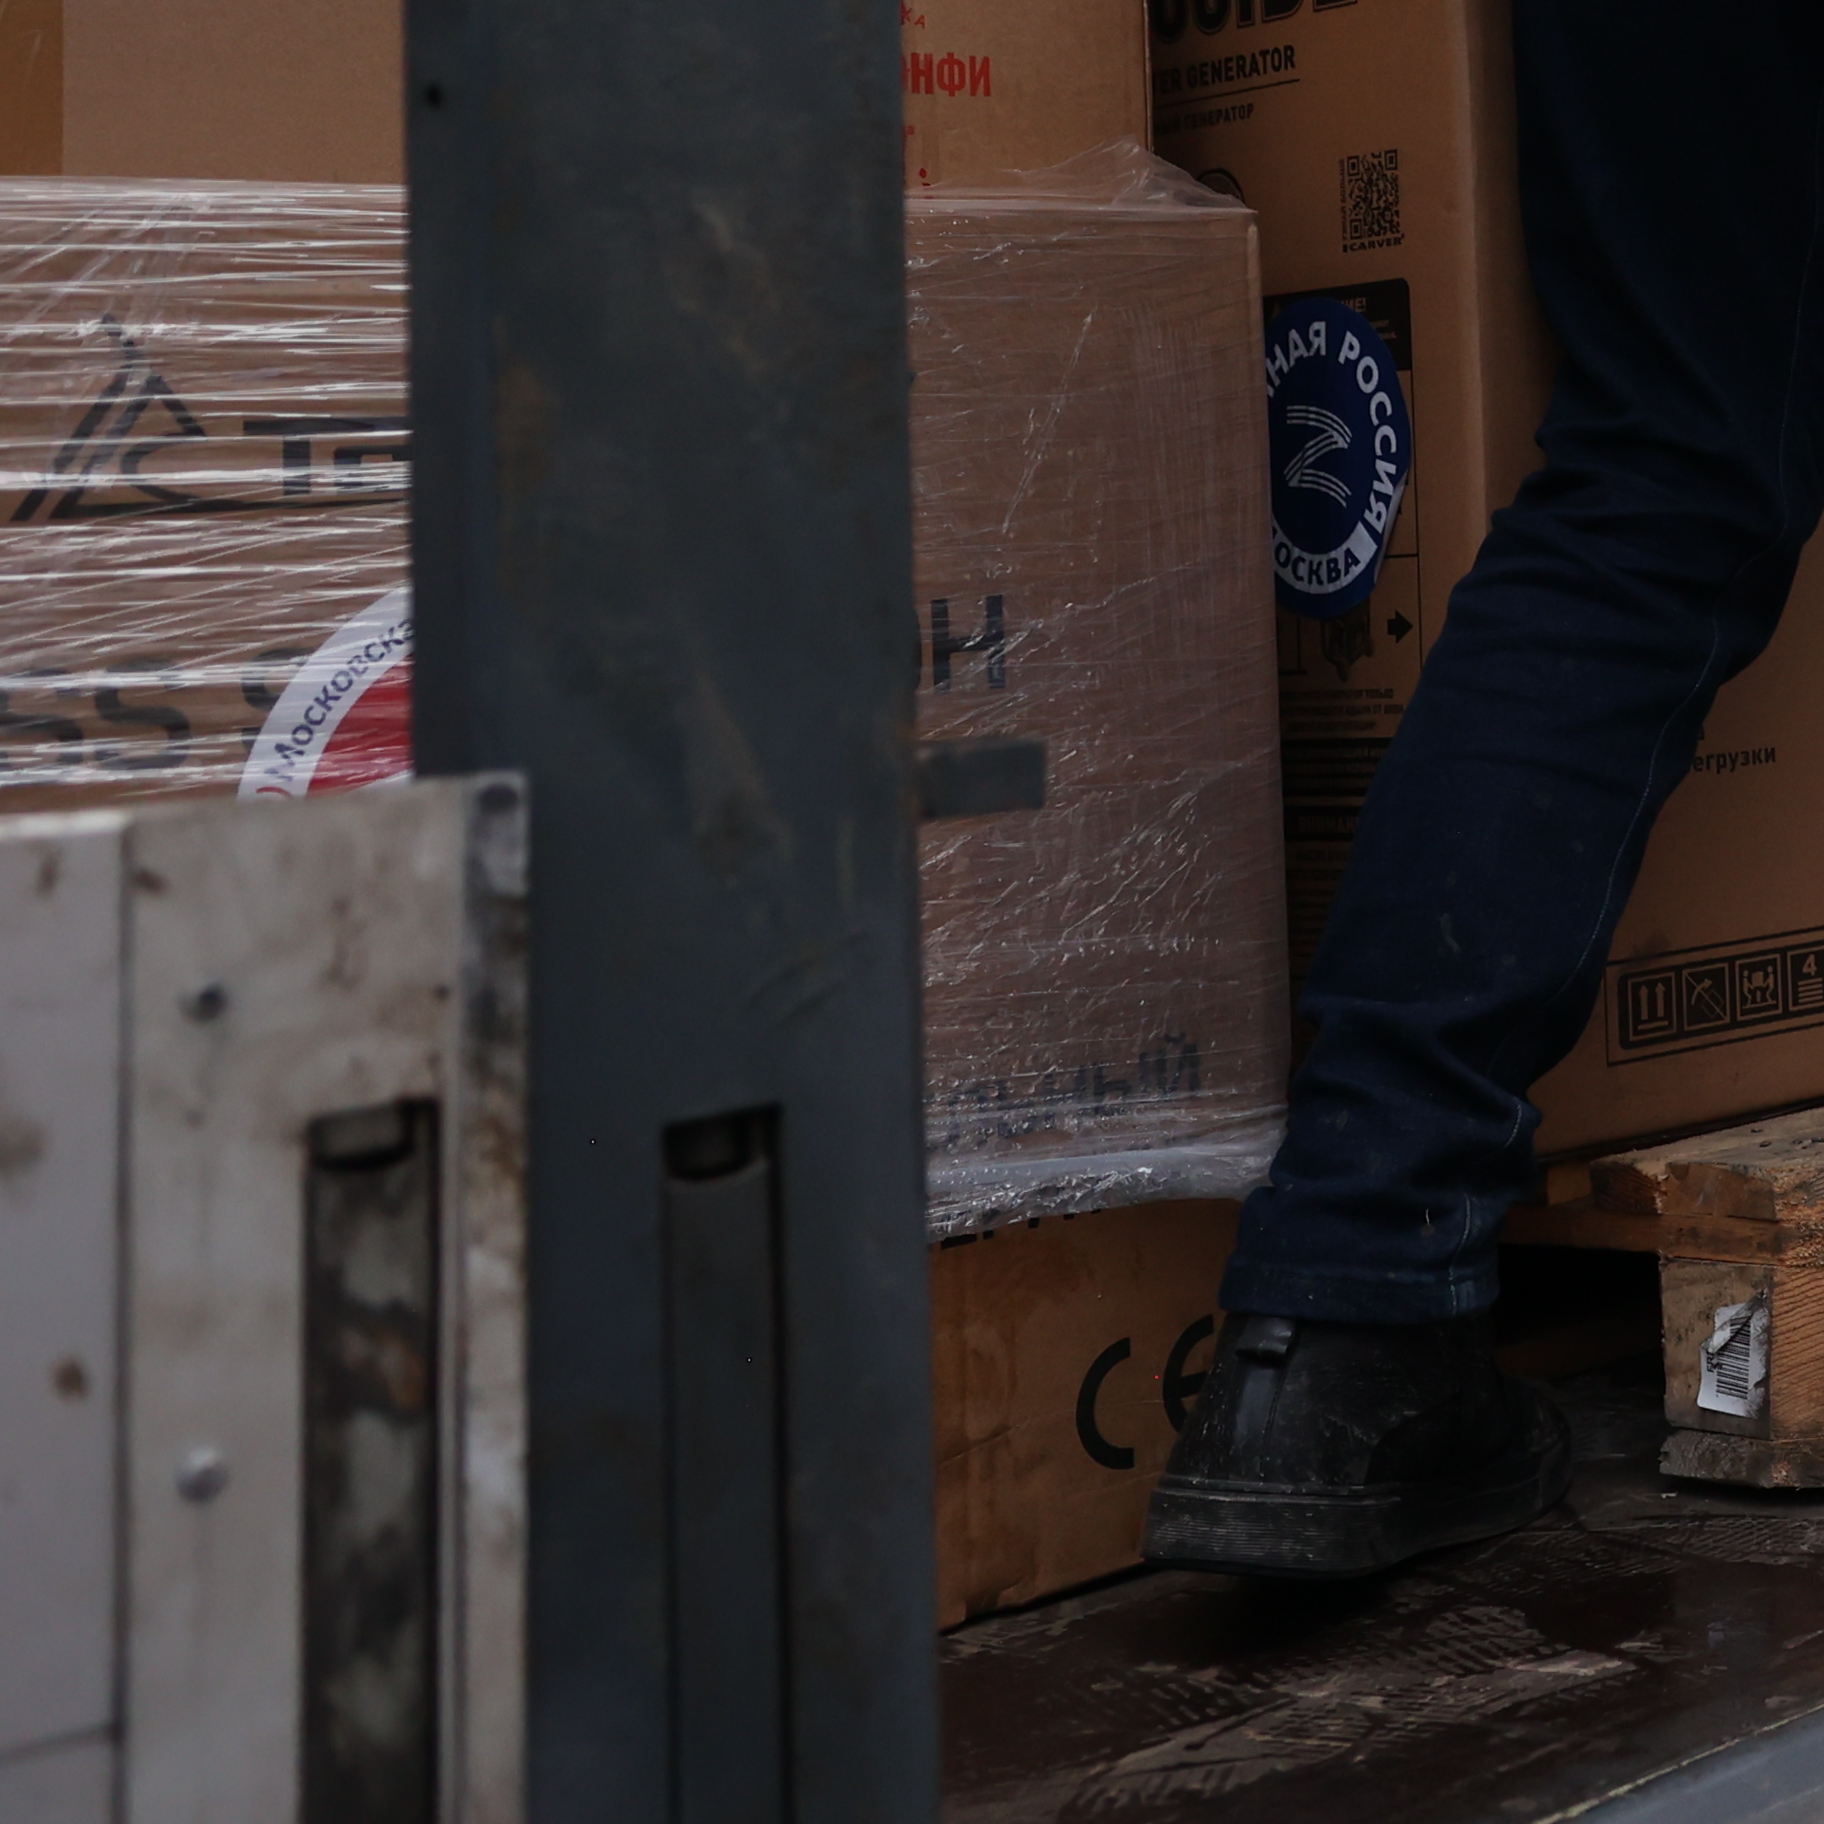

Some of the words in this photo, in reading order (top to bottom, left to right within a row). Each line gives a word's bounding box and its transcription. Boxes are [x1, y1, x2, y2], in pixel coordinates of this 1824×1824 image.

[1187, 45, 1296, 89] GENERATOR
[1350, 237, 1402, 252] CARVER
[1337, 330, 1398, 535] РОССИЯ
[1272, 536, 1361, 587] ОСКВА
[1691, 745, 1777, 774] егрузки
